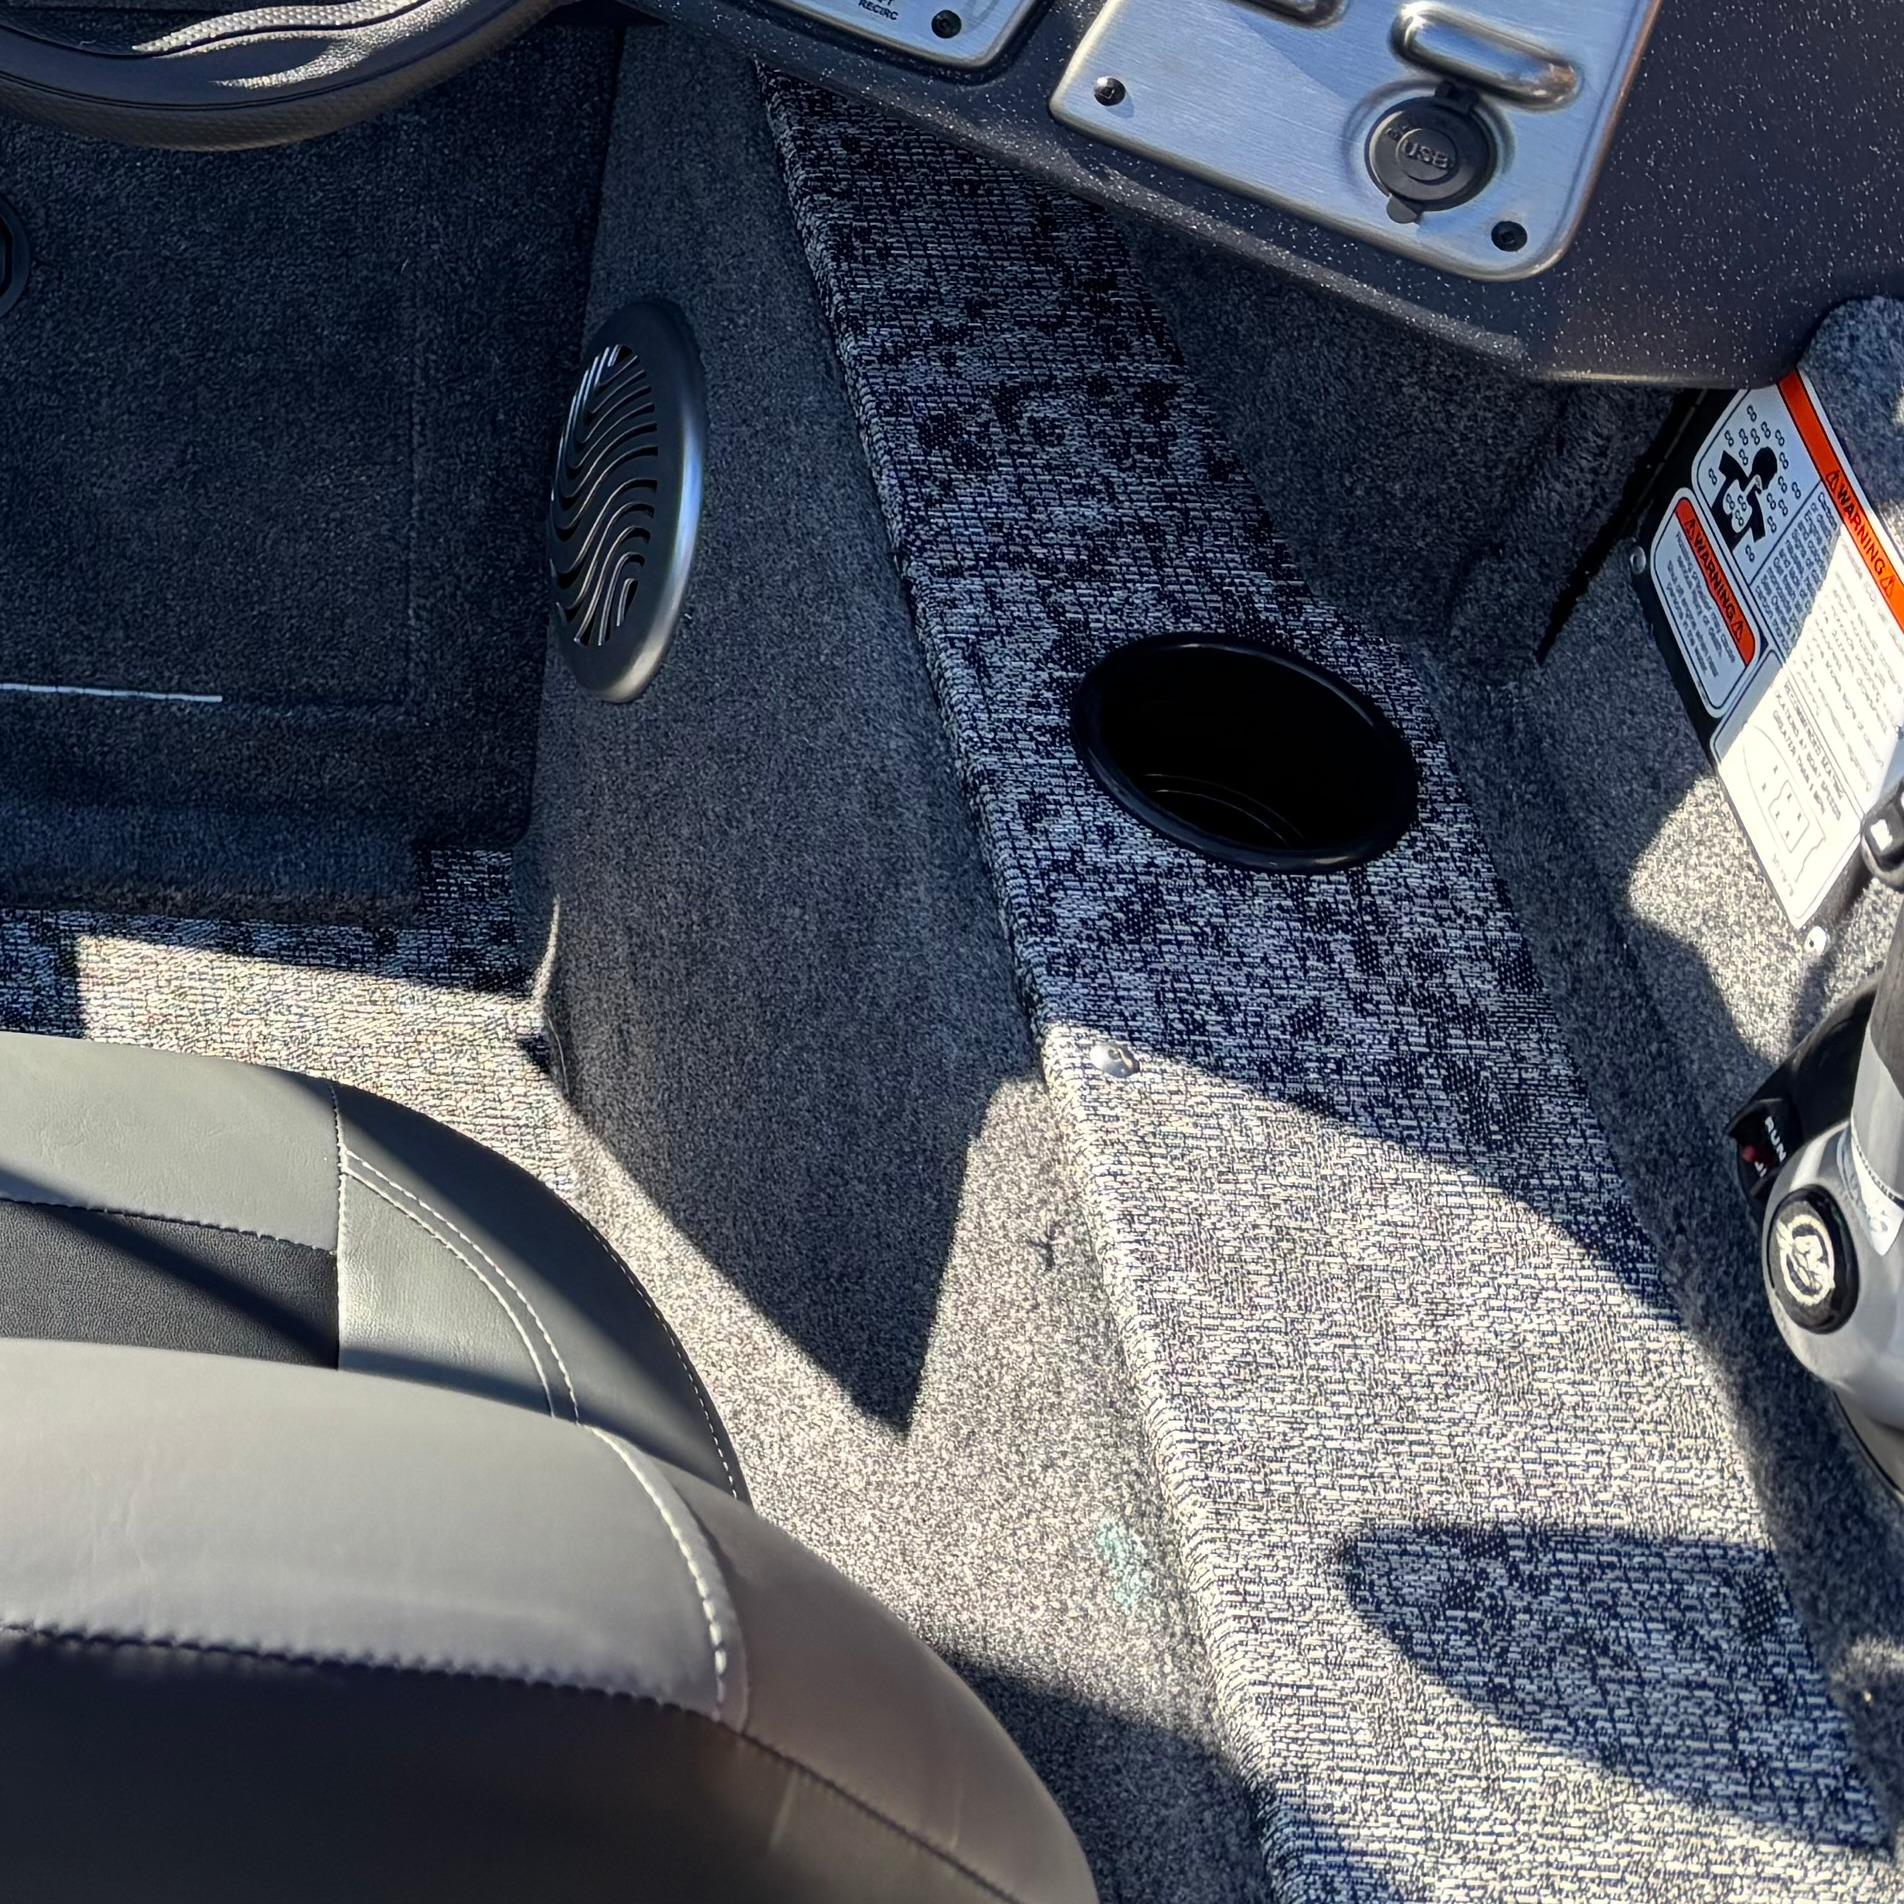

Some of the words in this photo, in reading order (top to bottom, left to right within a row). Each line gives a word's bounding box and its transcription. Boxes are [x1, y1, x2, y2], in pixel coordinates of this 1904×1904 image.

[1402, 139, 1448, 169] USB
[1837, 487, 1886, 576] WARNING
[1694, 536, 1736, 620] WARNING
[1763, 1115, 1787, 1164] RUN
